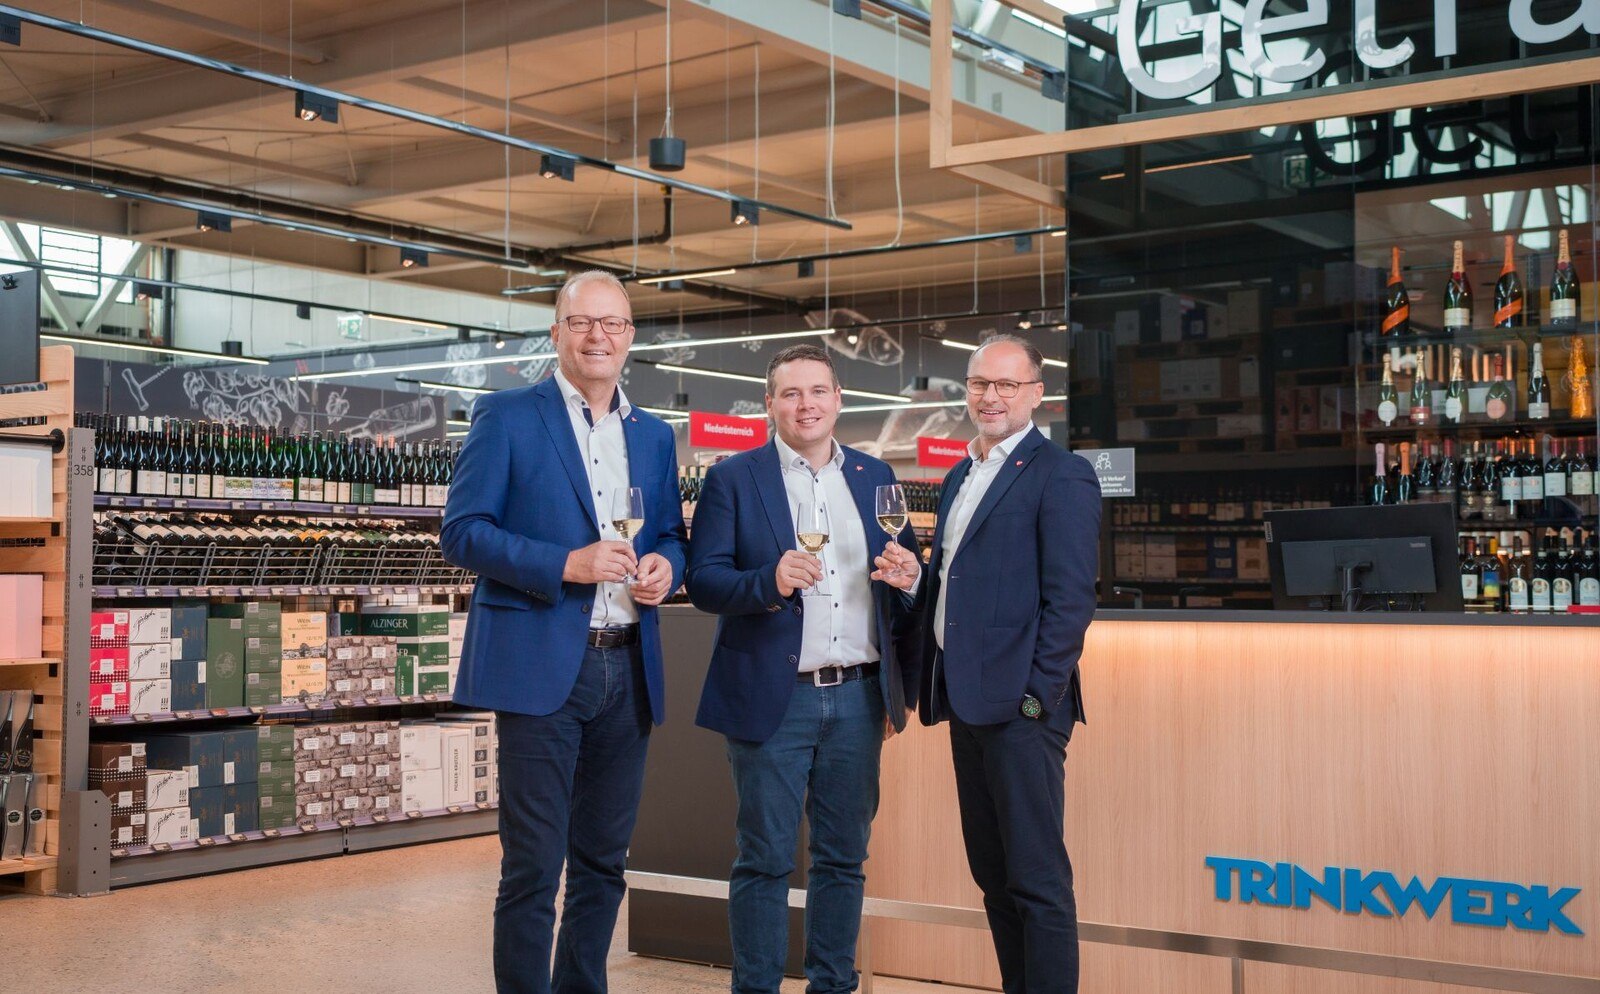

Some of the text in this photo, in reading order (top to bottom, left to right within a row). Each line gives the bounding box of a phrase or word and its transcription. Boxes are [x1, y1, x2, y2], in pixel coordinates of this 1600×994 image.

[704, 423, 754, 437] Niederösterreich
[73, 464, 94, 477] 358
[371, 618, 408, 629] ALZINGER
[1205, 856, 1585, 936] TRINKWERK
